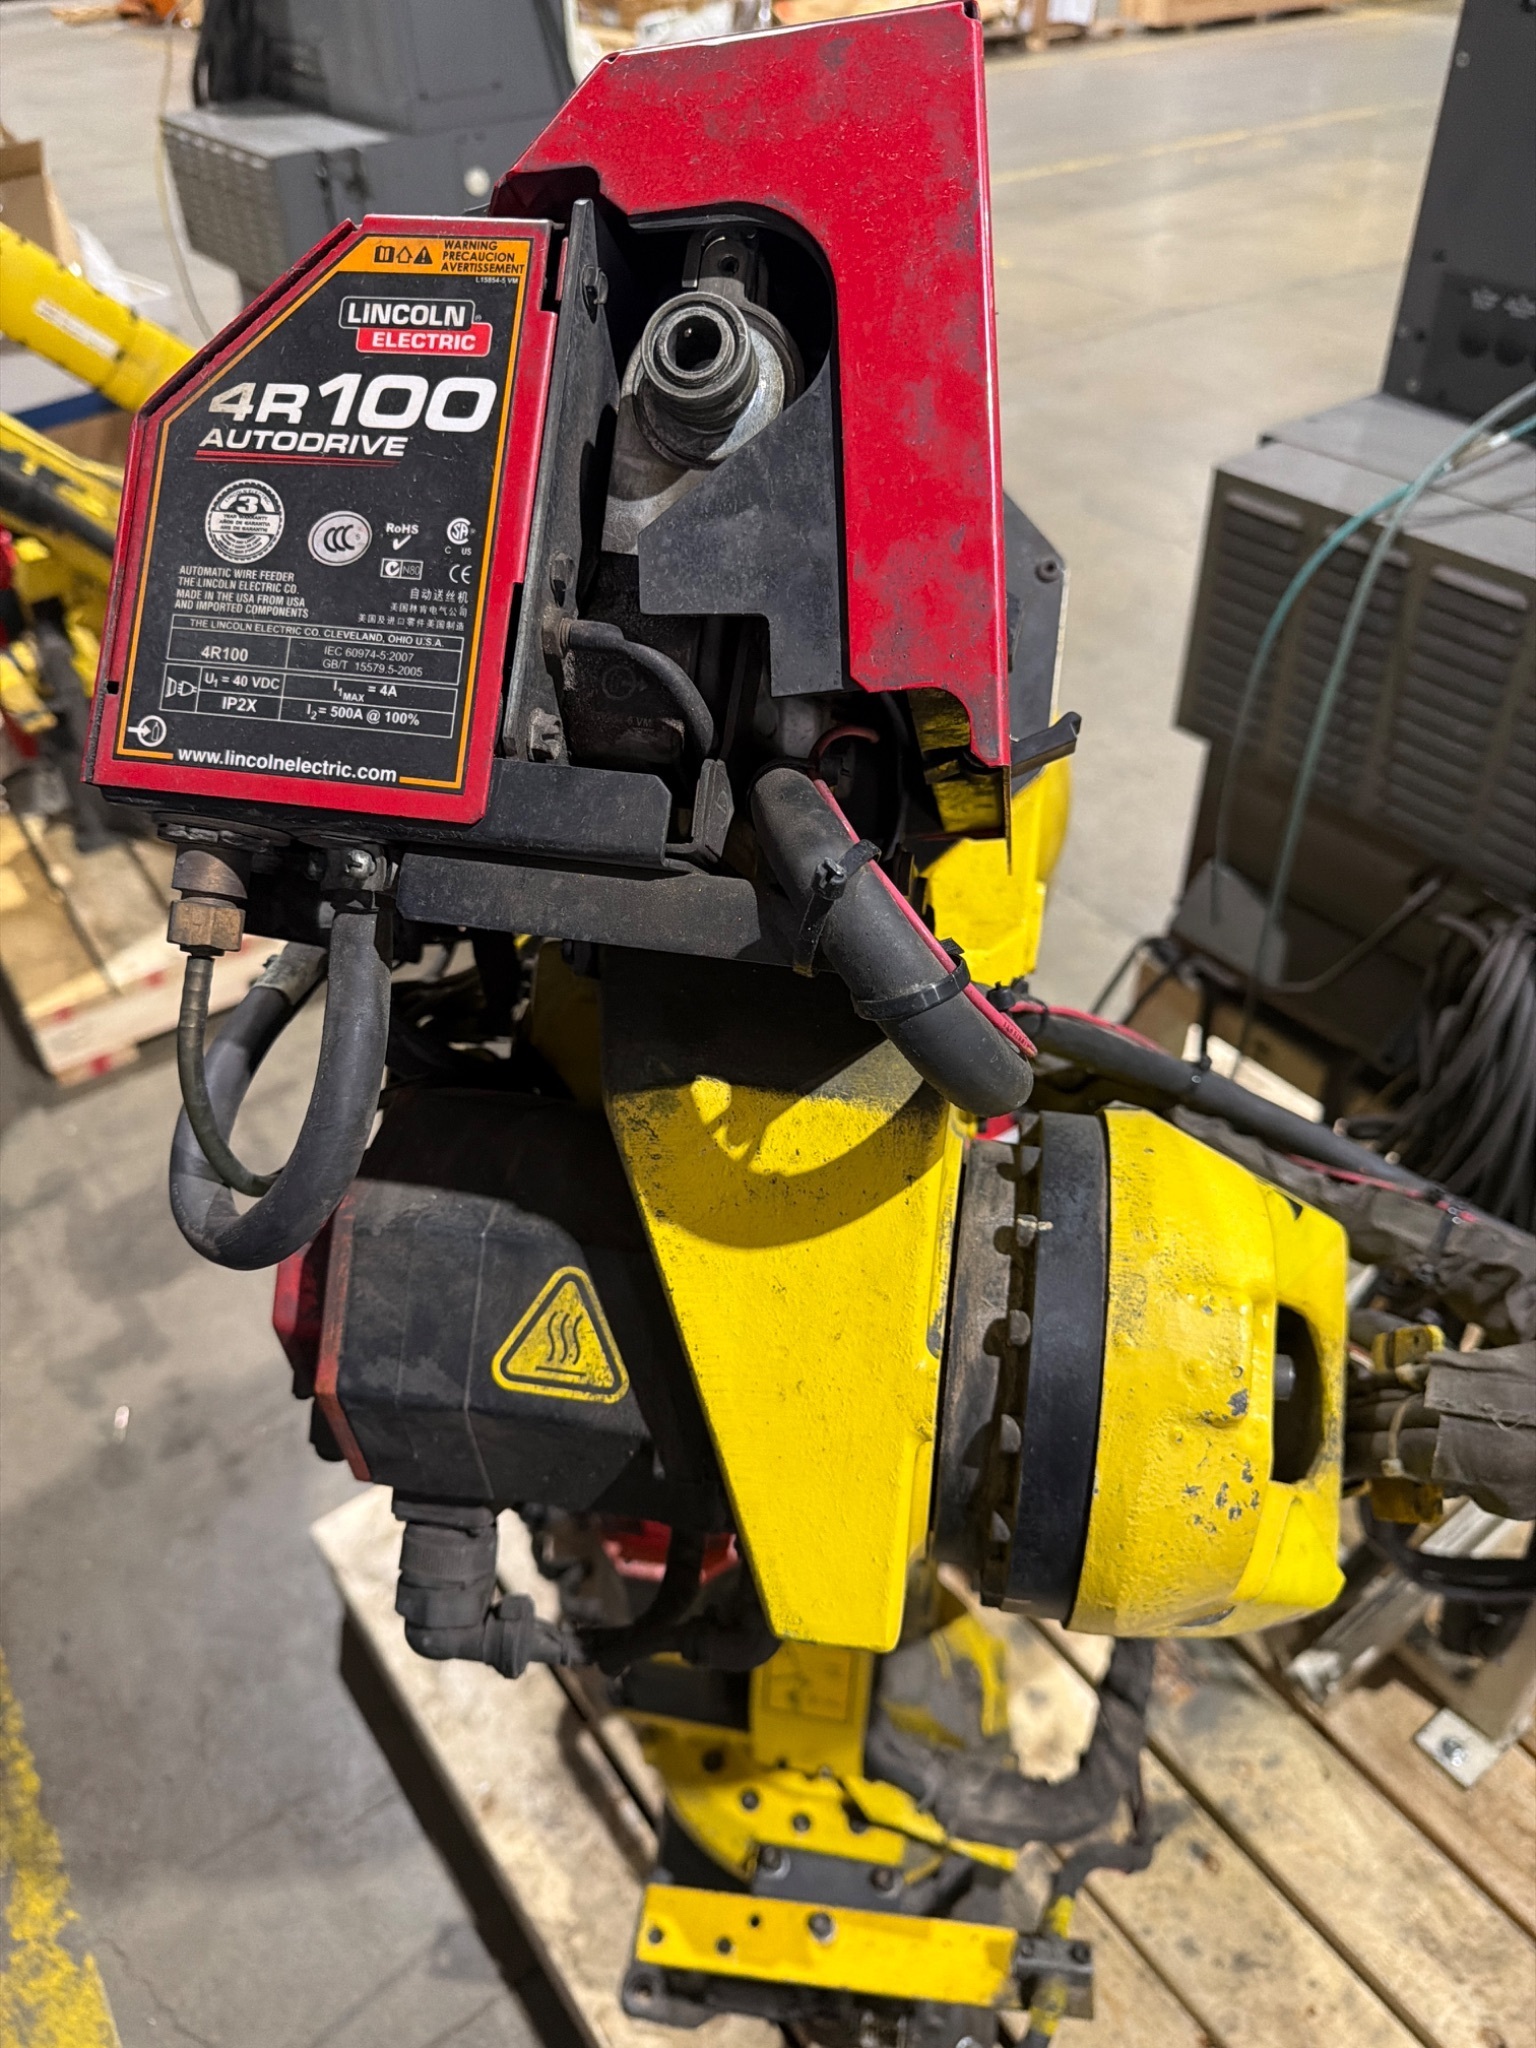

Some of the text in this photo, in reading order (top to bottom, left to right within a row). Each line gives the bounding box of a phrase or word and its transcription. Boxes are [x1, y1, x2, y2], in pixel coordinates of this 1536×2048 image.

[444, 240, 498, 250] WARNING
[442, 251, 515, 262] PRECAUCION
[440, 262, 525, 274] AVERTISSEMENT
[347, 302, 466, 327] LINCOLN
[372, 331, 476, 351] ELECTRIC
[199, 428, 409, 457] AUTODRIVE
[236, 495, 259, 514] 3
[386, 522, 419, 534] RoHS
[444, 546, 472, 556] C US
[180, 565, 295, 582] AUTOMATIC WIRE FEEDER
[449, 564, 473, 584] CE
[178, 576, 300, 595] THE LINCOLN ELECTRIC CO.
[176, 588, 306, 608] MADE IN THE USA FROM USA
[410, 587, 469, 604] 自动送丝机
[174, 600, 309, 619] AND IMPORTED COMPONENTS
[190, 618, 445, 648] THE LINCOLN ELECTRIC CO. CLEVELAND, OHIO U.S.A.
[200, 645, 249, 662] 4R100
[324, 645, 414, 662] IEC 60974-5:2007
[322, 658, 424, 677] GB/T 15579.5-2005
[232, 675, 248, 688] 40
[252, 676, 280, 690] VDC
[379, 684, 398, 698] 4A
[222, 696, 258, 713] IP2X
[330, 705, 364, 721] 500A
[366, 709, 380, 725] @
[384, 710, 420, 726] 100%
[178, 748, 397, 783] www.lincolnelectric.com
